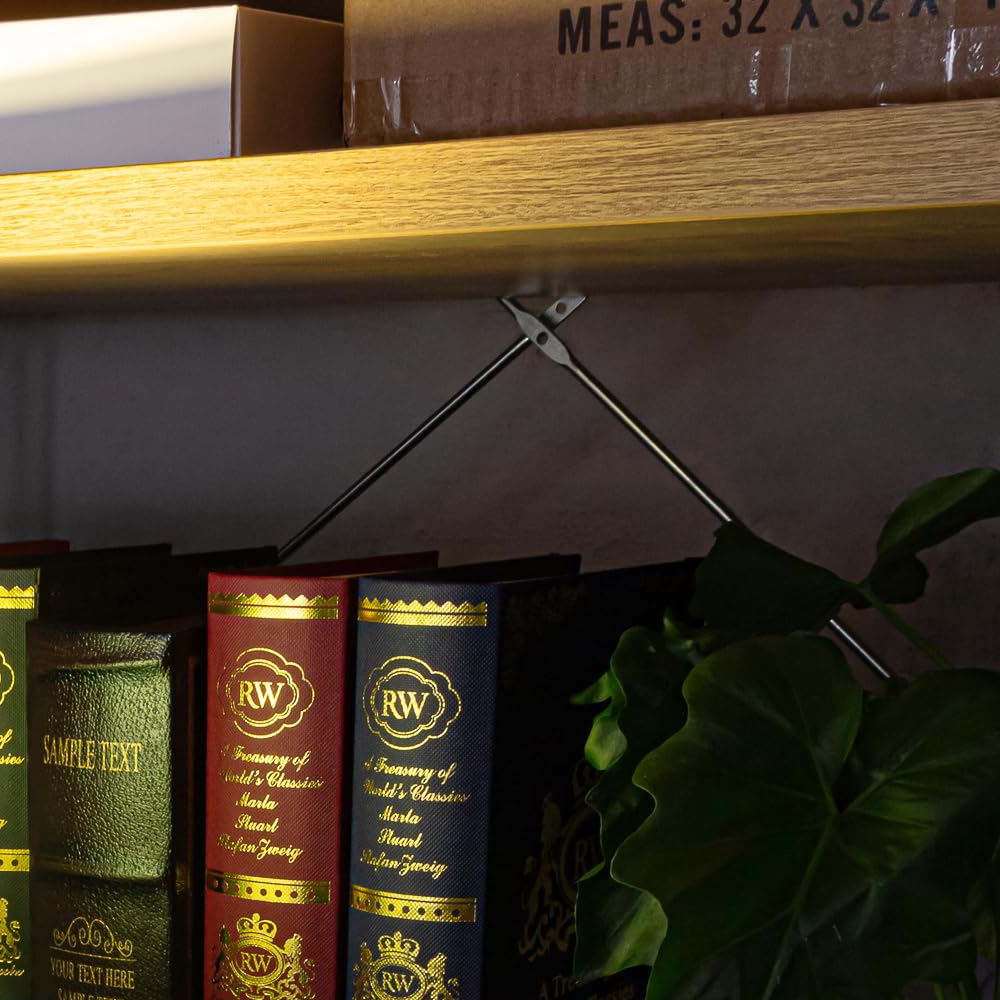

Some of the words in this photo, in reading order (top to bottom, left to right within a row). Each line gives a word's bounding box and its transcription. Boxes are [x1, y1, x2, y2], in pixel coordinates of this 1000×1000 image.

[558, 0, 700, 55] MEAS:
[237, 680, 286, 709] RW
[381, 690, 430, 720] RW
[43, 735, 95, 770] SAMPLE
[100, 740, 142, 773] TEXT
[292, 750, 311, 772] of
[265, 770, 324, 789] Classics
[374, 757, 436, 784] Treasury
[437, 762, 458, 785] of
[410, 783, 470, 803] Classics
[50, 957, 75, 980] YOUR
[77, 963, 104, 986] TEXT
[106, 967, 136, 990] HERE
[240, 952, 274, 973] RW
[381, 971, 415, 993] RW
